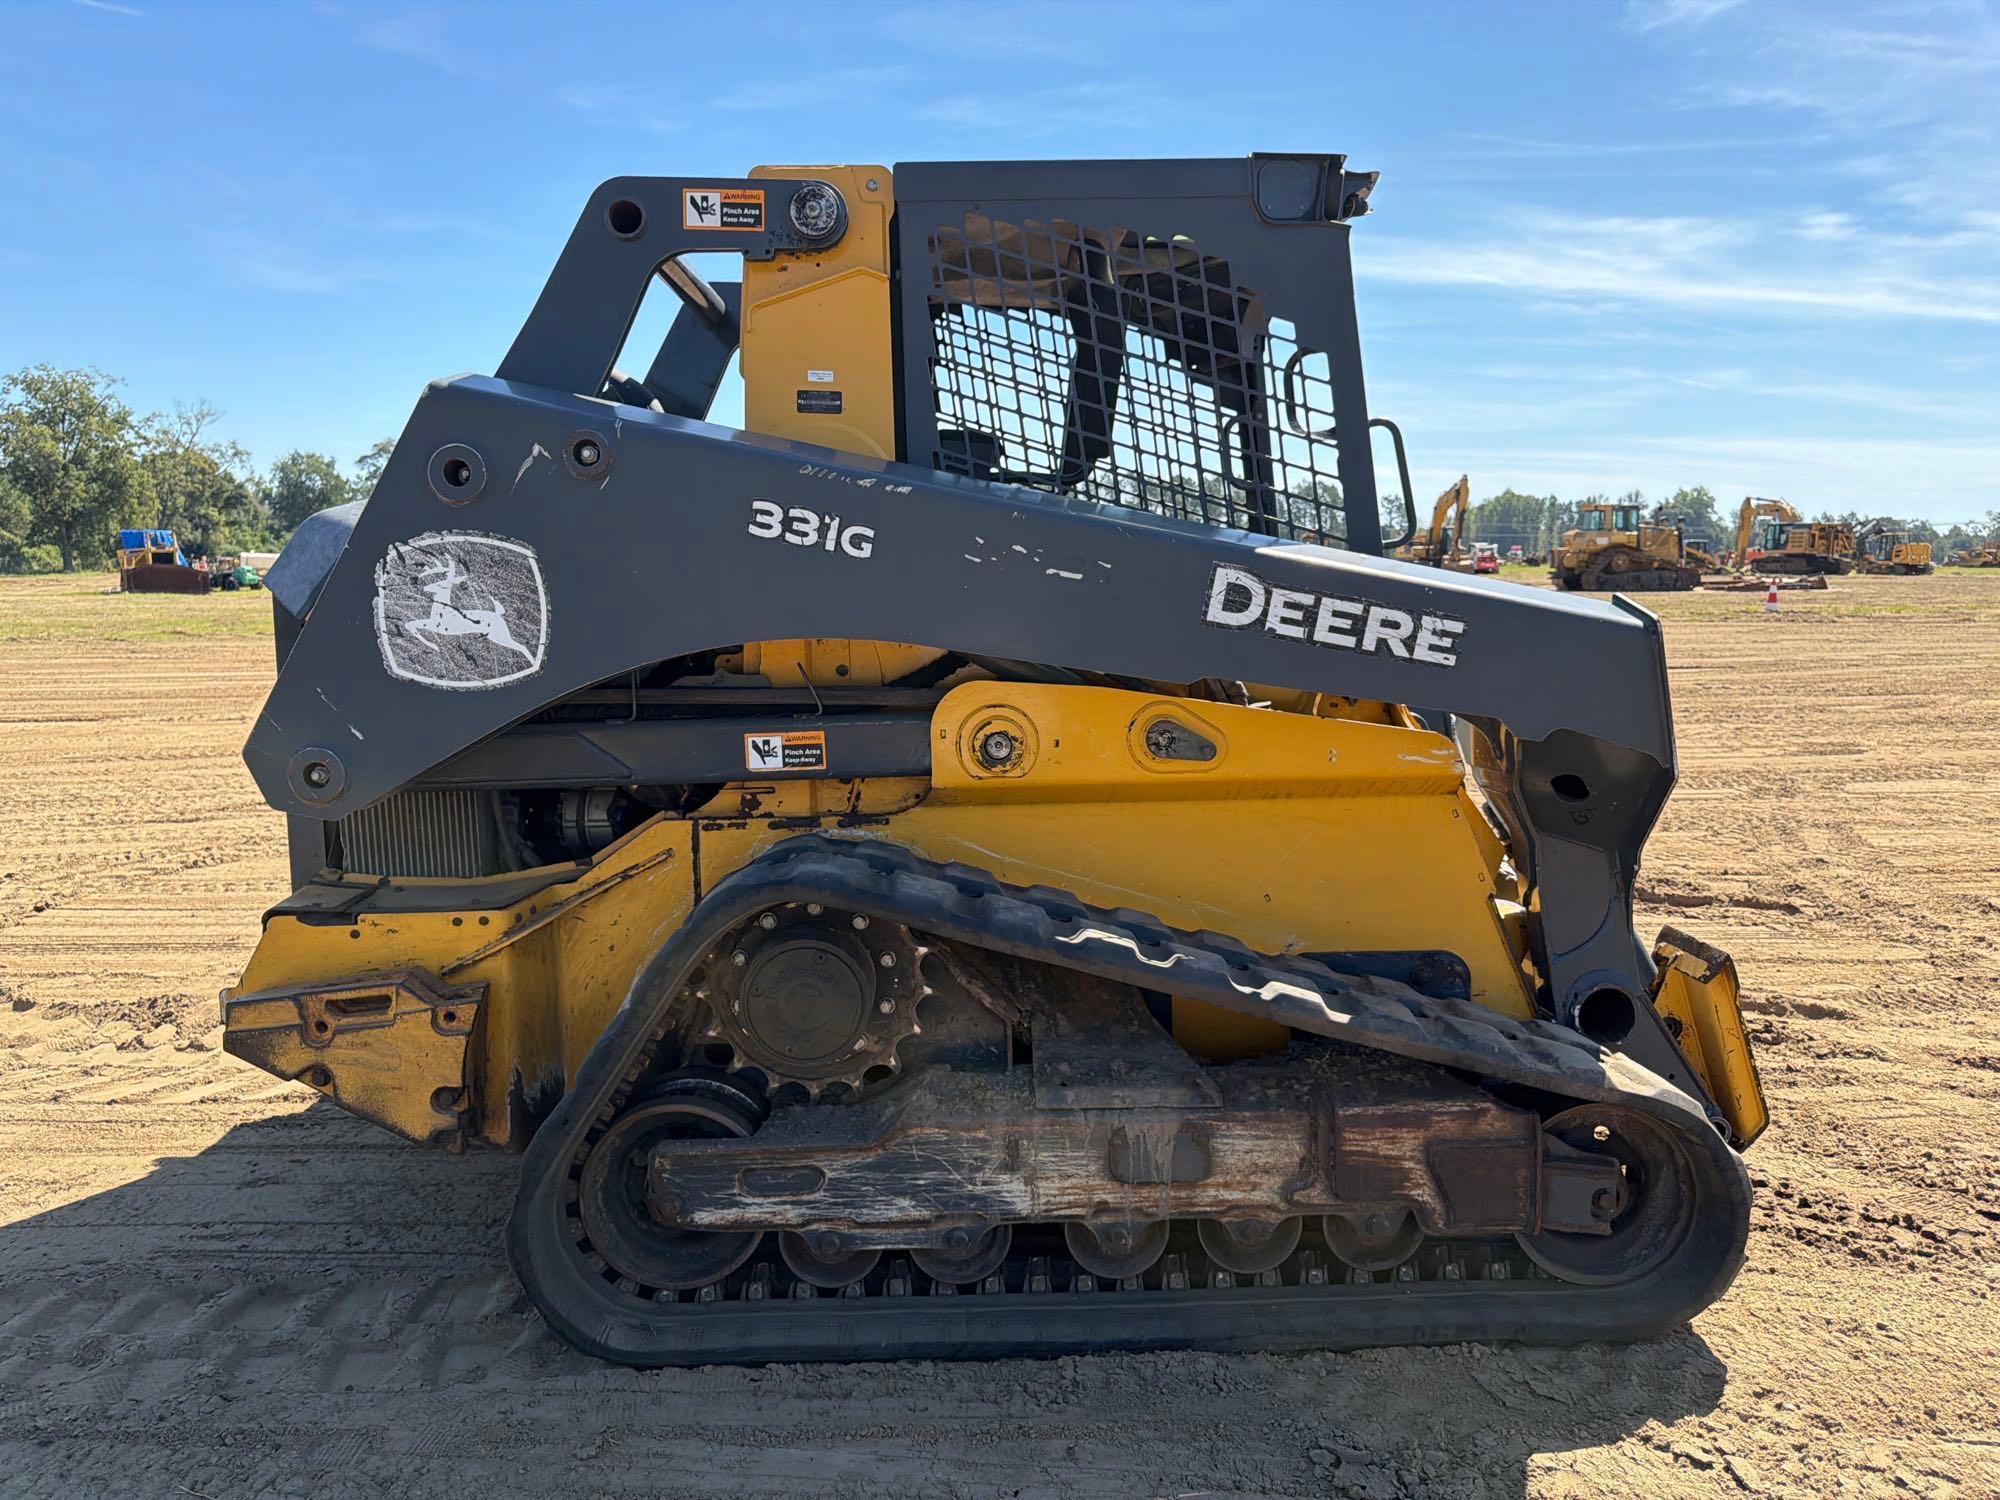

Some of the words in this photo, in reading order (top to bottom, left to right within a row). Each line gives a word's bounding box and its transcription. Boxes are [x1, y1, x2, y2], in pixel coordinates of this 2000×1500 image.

[730, 192, 761, 200] WARNING
[723, 207, 742, 215] Pinch
[744, 207, 760, 215] Area
[739, 216, 755, 224] Away
[748, 500, 875, 558] 331G
[1206, 566, 1465, 667] DEERE
